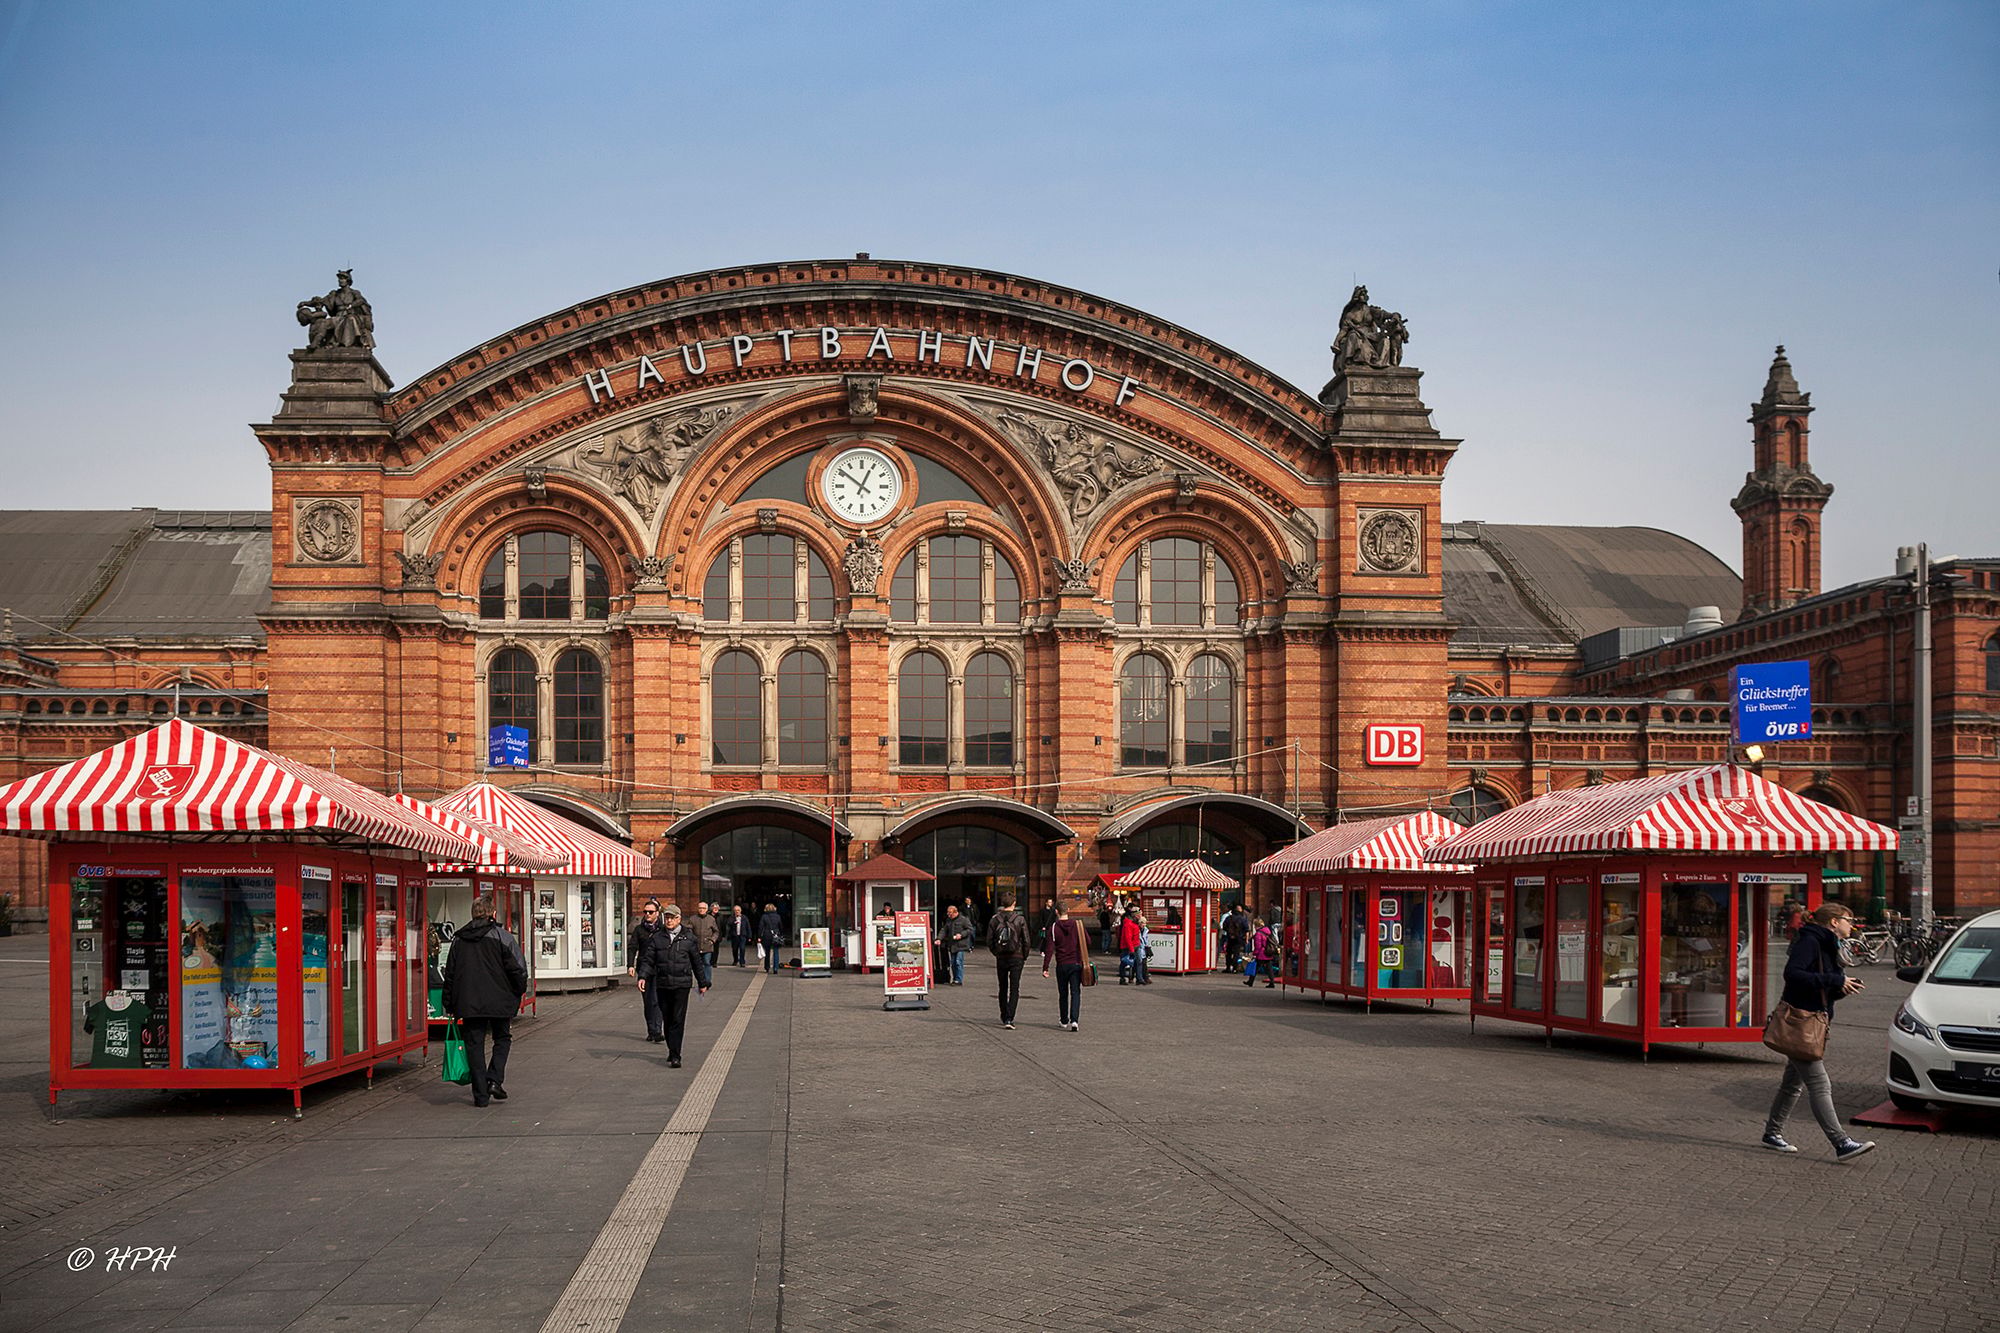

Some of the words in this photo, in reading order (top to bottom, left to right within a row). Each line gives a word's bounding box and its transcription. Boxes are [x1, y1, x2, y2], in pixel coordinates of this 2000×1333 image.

[585, 327, 1139, 406] HAUPTBAHNHOF
[1740, 677, 1754, 686] Ein
[1740, 685, 1809, 701] Glückstreffer
[1745, 703, 1758, 712] für
[1765, 721, 1798, 736] ÖVB
[1375, 730, 1417, 758] DB
[78, 864, 104, 876] ÖVB
[182, 866, 274, 875] www.buergerpark-tombola.de
[302, 866, 311, 877] ÖVB
[264, 877, 275, 887] fü
[1743, 874, 1762, 882] ÖVB
[302, 890, 321, 900] zeit.
